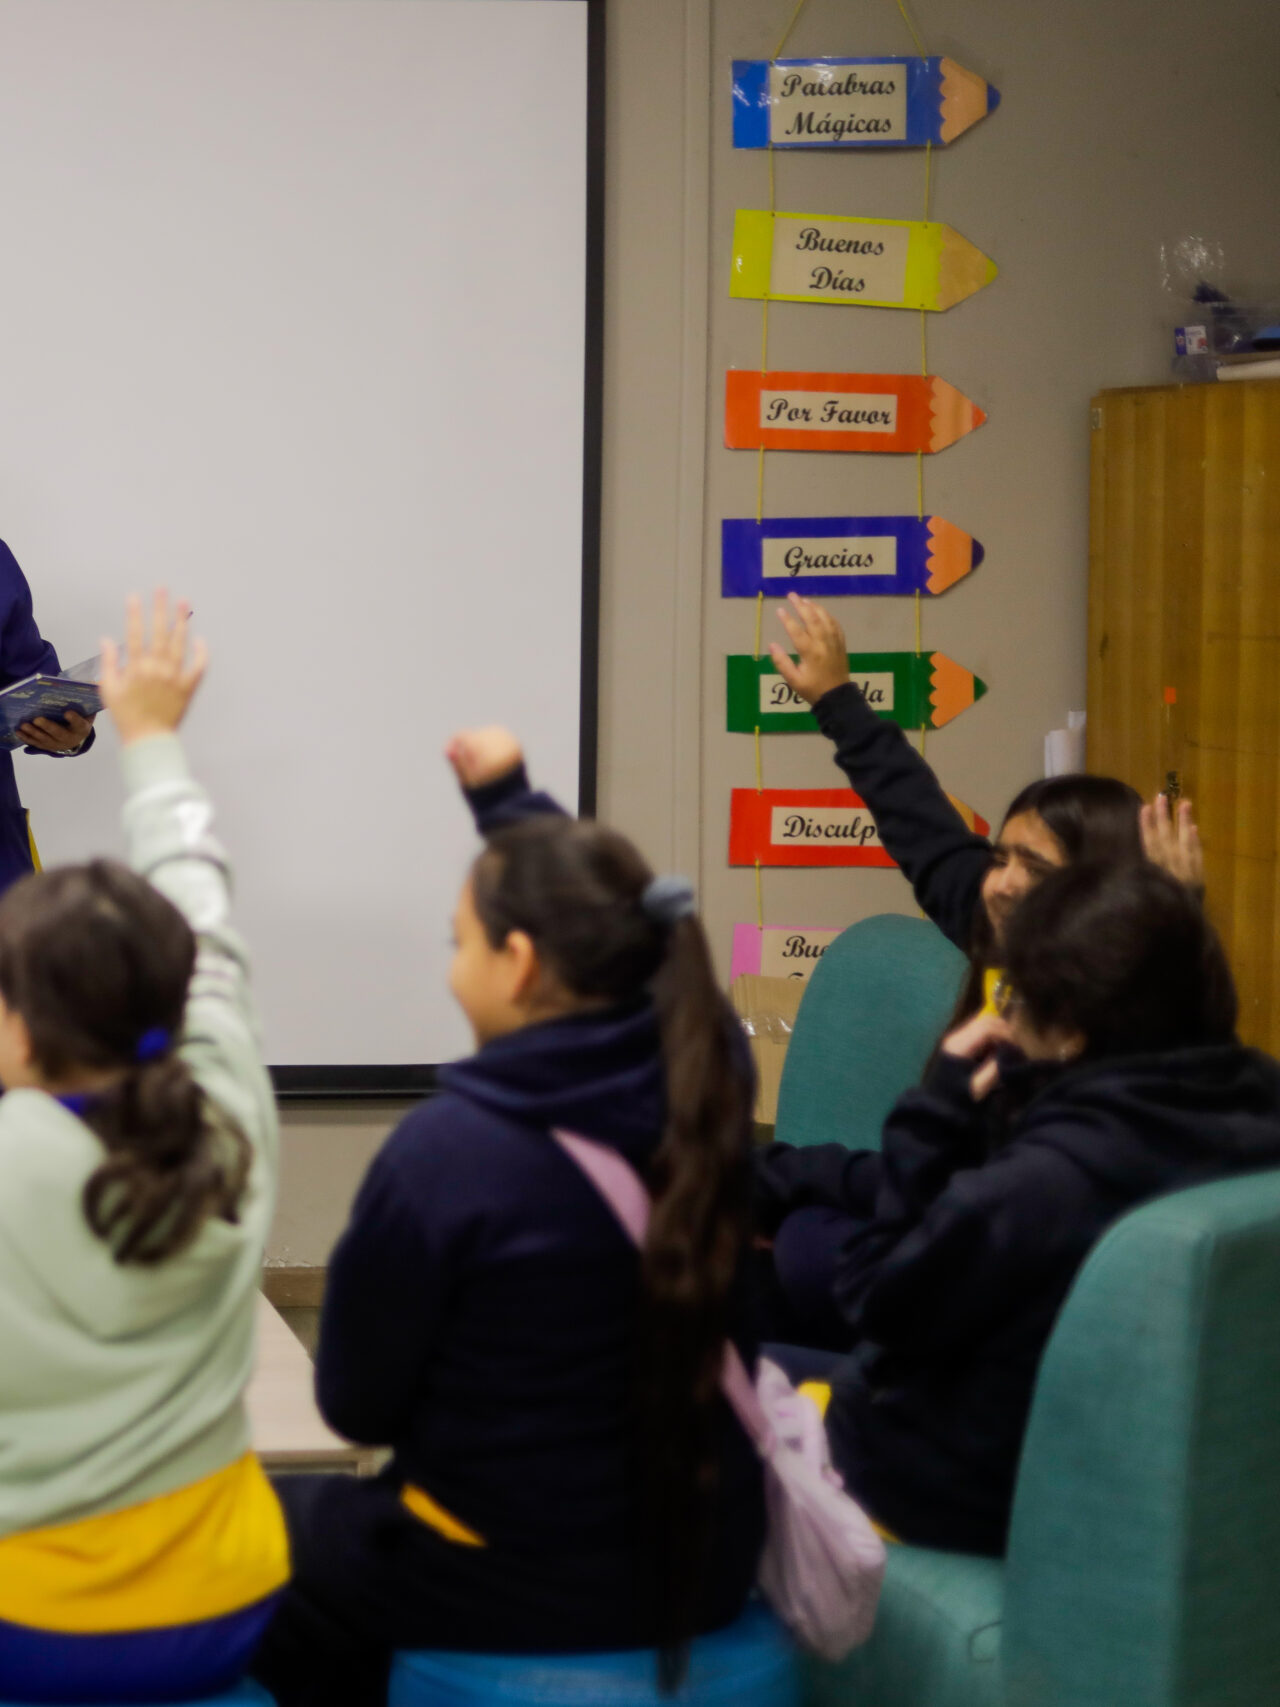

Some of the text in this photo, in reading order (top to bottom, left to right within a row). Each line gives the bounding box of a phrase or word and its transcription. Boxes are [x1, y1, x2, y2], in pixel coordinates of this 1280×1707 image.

[780, 73, 896, 97] Palabras
[785, 111, 892, 141] Mágicas
[795, 227, 885, 256] Buenos
[809, 266, 866, 293] Días
[766, 398, 892, 425] Por Favor
[783, 546, 874, 577] Gracias
[783, 814, 877, 846] Disculp
